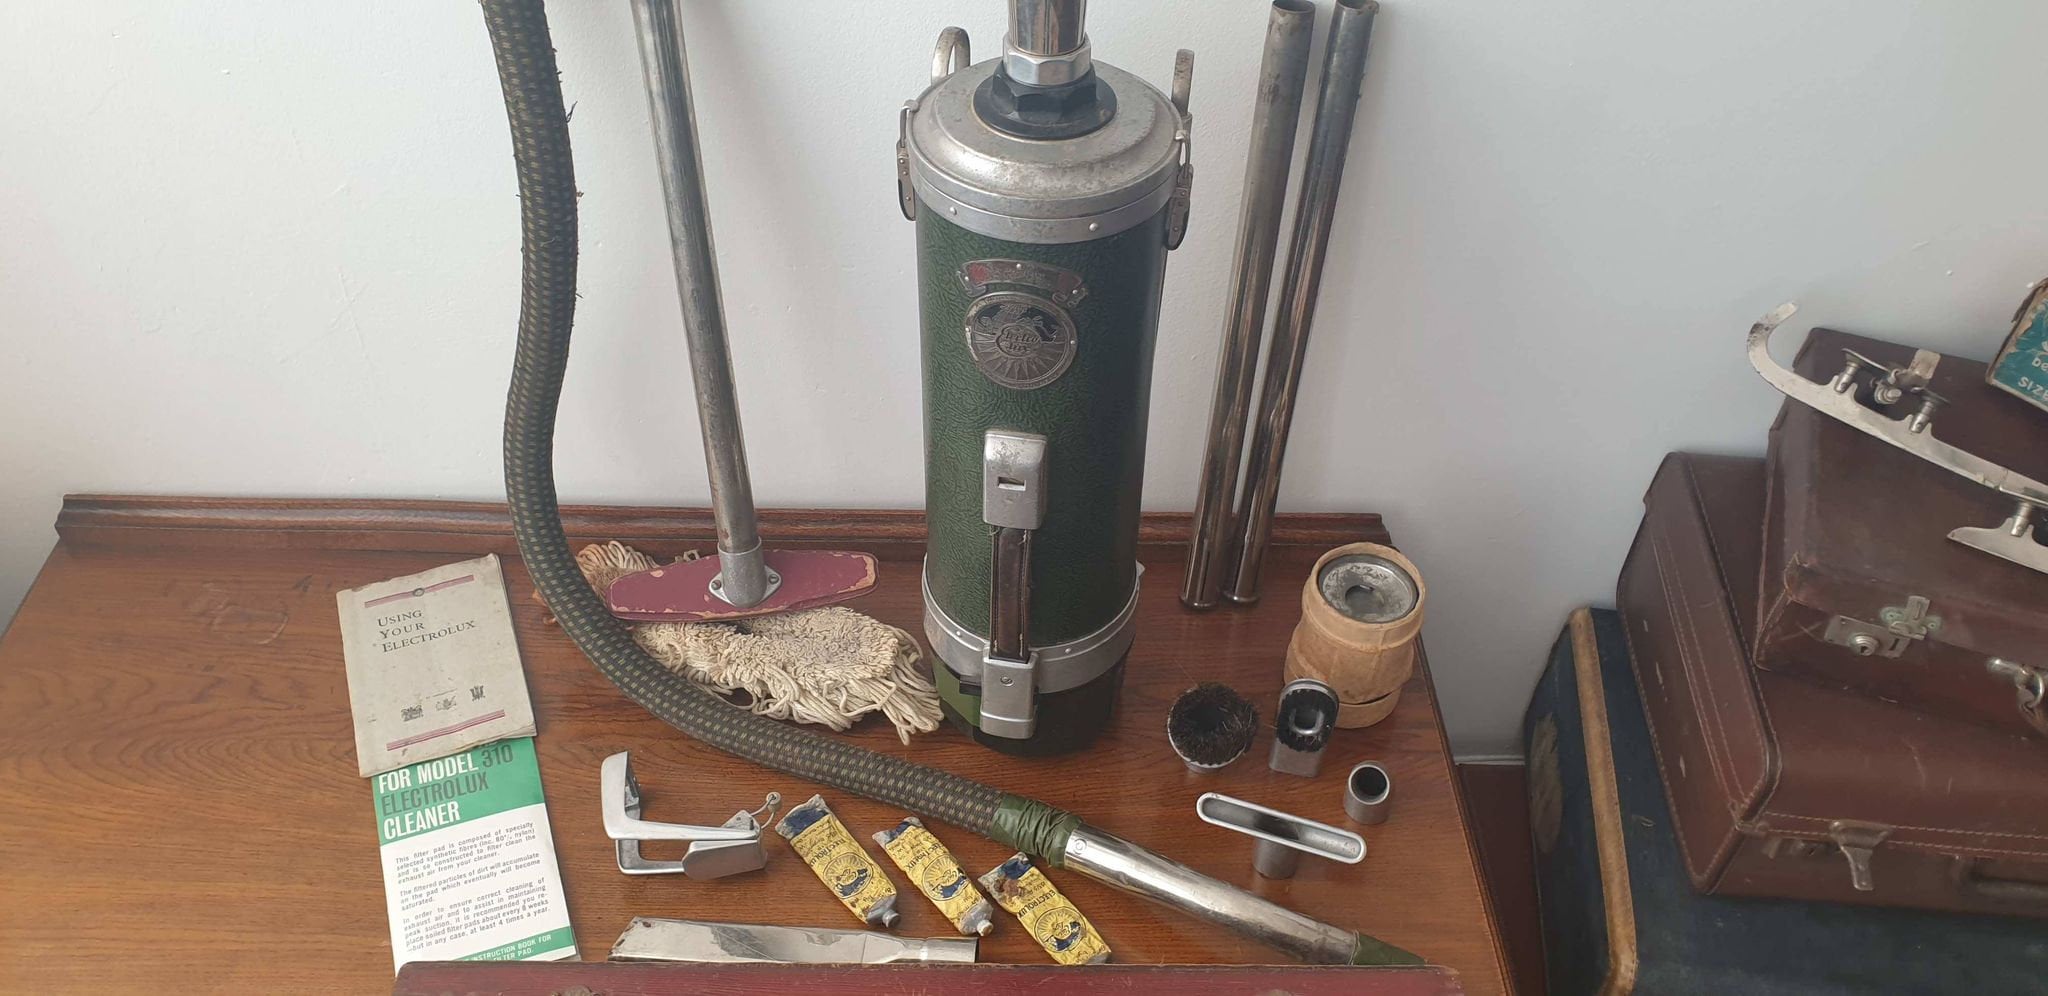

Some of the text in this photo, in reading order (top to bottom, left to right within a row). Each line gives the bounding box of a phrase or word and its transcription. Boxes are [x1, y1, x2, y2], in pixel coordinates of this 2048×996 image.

[377, 609, 423, 627] USING
[379, 622, 425, 640] YOUR
[382, 619, 476, 653] ELECTROLUX
[378, 744, 514, 794] FOR MODEL 310
[380, 771, 490, 817] ELECTROLUX
[383, 800, 461, 841] CLEANER
[396, 856, 410, 865] This
[413, 850, 429, 859] filter
[433, 844, 446, 855] pad
[458, 832, 491, 846] composed
[495, 829, 502, 837] of
[505, 822, 534, 834] specially
[397, 858, 424, 871] selected
[427, 849, 457, 863] synthetic
[459, 842, 477, 853] fibres
[515, 828, 535, 838] nylon)
[398, 869, 410, 878] and
[434, 850, 474, 867] constructed
[487, 843, 502, 851] filter
[505, 838, 523, 847] clean
[525, 834, 536, 842] the
[398, 872, 424, 884] exhaust
[438, 864, 454, 872] from
[456, 859, 471, 868] your
[474, 851, 500, 862] cleaner.
[400, 852, 540, 897] The filtered particles of dirt will accumulate
[412, 892, 423, 901] the
[426, 887, 438, 897] pad
[442, 881, 461, 892] which
[464, 871, 497, 885] eventually
[501, 866, 512, 874] will
[515, 859, 541, 870] become
[404, 918, 431, 932] exhaust
[447, 909, 460, 918] and
[474, 899, 495, 910] assist
[508, 885, 547, 900] maintaining
[405, 929, 421, 940] peak
[473, 899, 520, 918] recommended
[522, 895, 535, 905] you
[414, 910, 433, 920] order
[449, 899, 472, 910] ensure
[477, 890, 501, 901] correct
[505, 881, 533, 893] cleaning
[1018, 889, 1056, 918] ELECTROLUX
[405, 935, 424, 948] place
[425, 928, 446, 939] soiled
[446, 924, 463, 933] filter
[463, 919, 480, 930] pads
[481, 913, 501, 923] about
[502, 908, 520, 918] every
[527, 899, 549, 909] weeks
[434, 937, 447, 945] any
[479, 921, 496, 932] least
[505, 913, 524, 924] times
[533, 906, 550, 917] year.
[517, 940, 537, 951] BOOK
[538, 934, 552, 944] FOR
